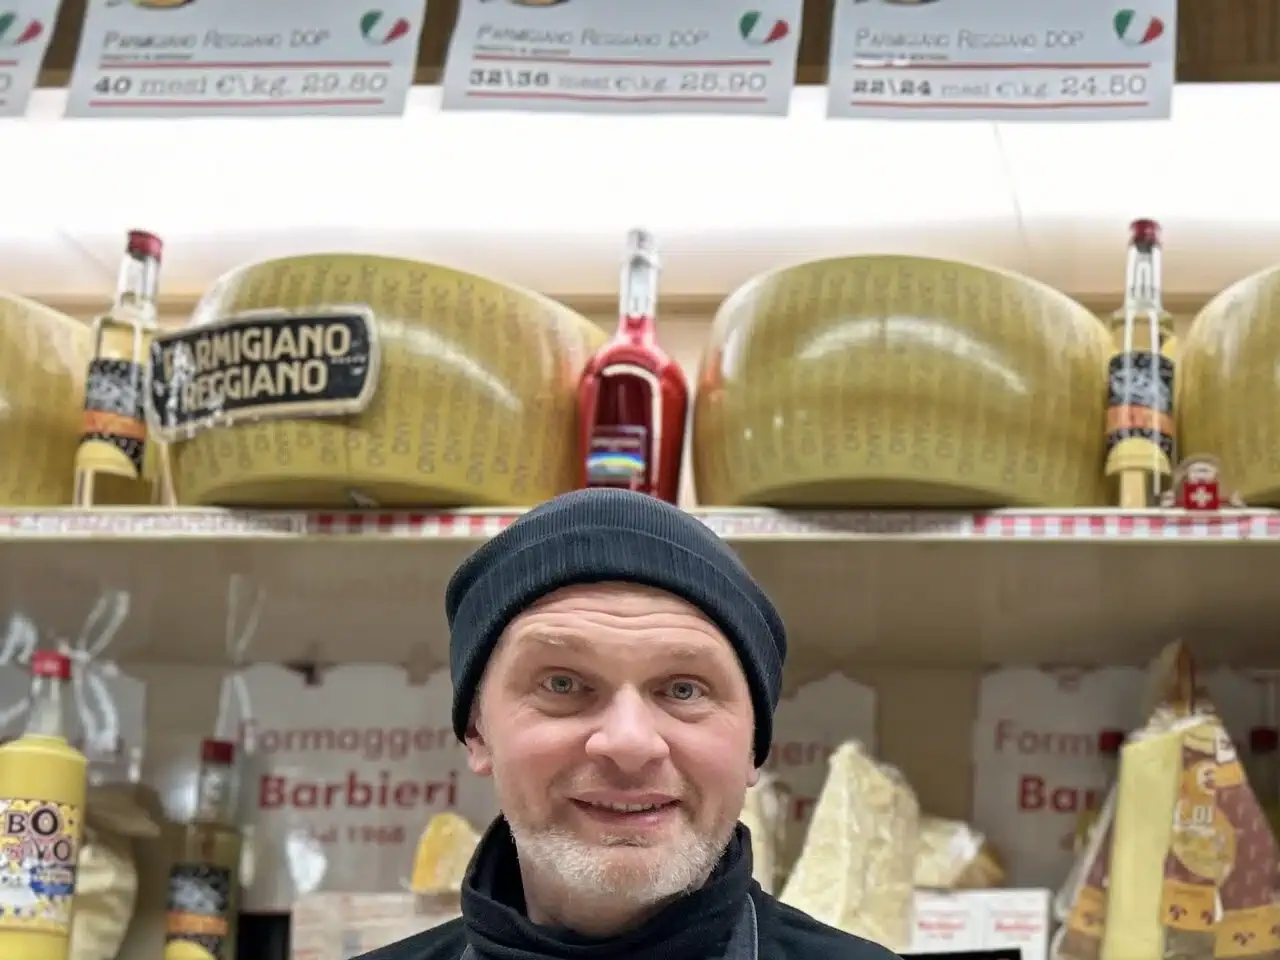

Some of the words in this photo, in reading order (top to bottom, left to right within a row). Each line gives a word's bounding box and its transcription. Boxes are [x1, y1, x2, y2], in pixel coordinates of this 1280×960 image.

[93, 75, 132, 94] 40
[181, 357, 329, 413] REGGIANO
[258, 769, 459, 809] Barbieri
